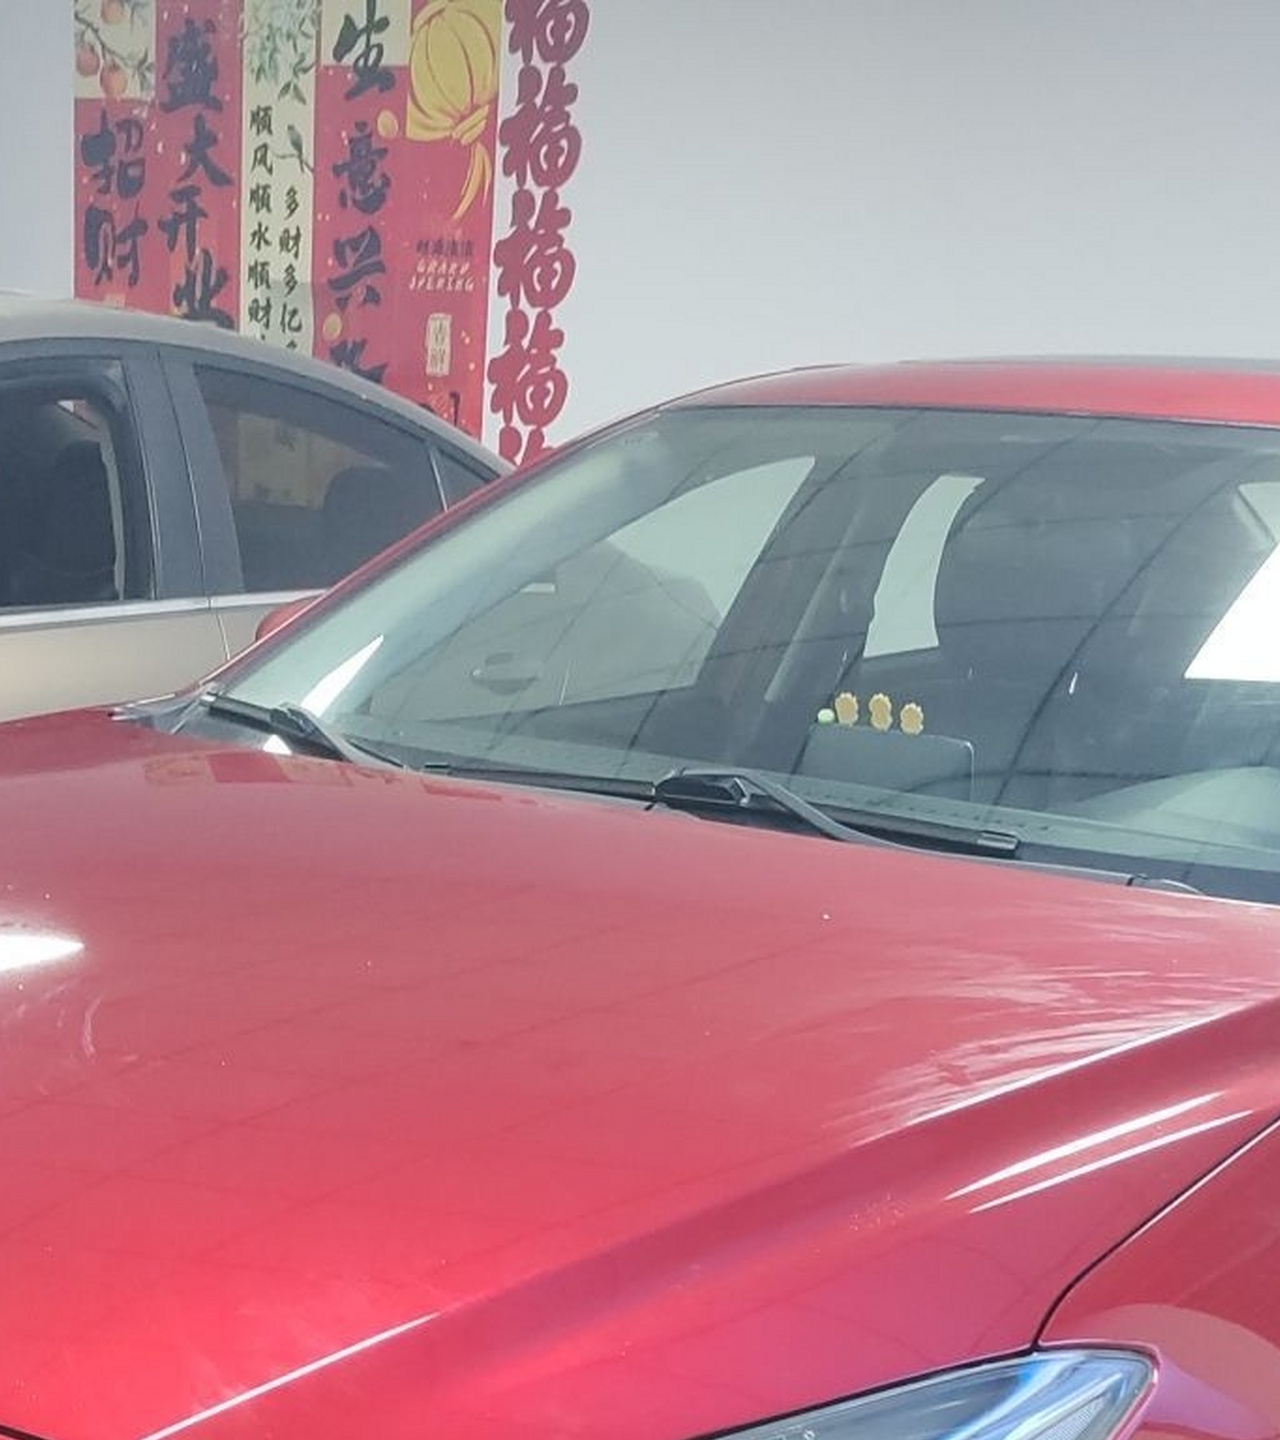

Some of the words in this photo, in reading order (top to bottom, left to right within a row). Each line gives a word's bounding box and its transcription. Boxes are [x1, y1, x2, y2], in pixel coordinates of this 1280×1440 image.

[80, 107, 150, 288] 招财
[157, 18, 236, 330] 盛大开业
[247, 104, 273, 341] 顺风顺水顺财
[278, 185, 304, 350] 多财多亿
